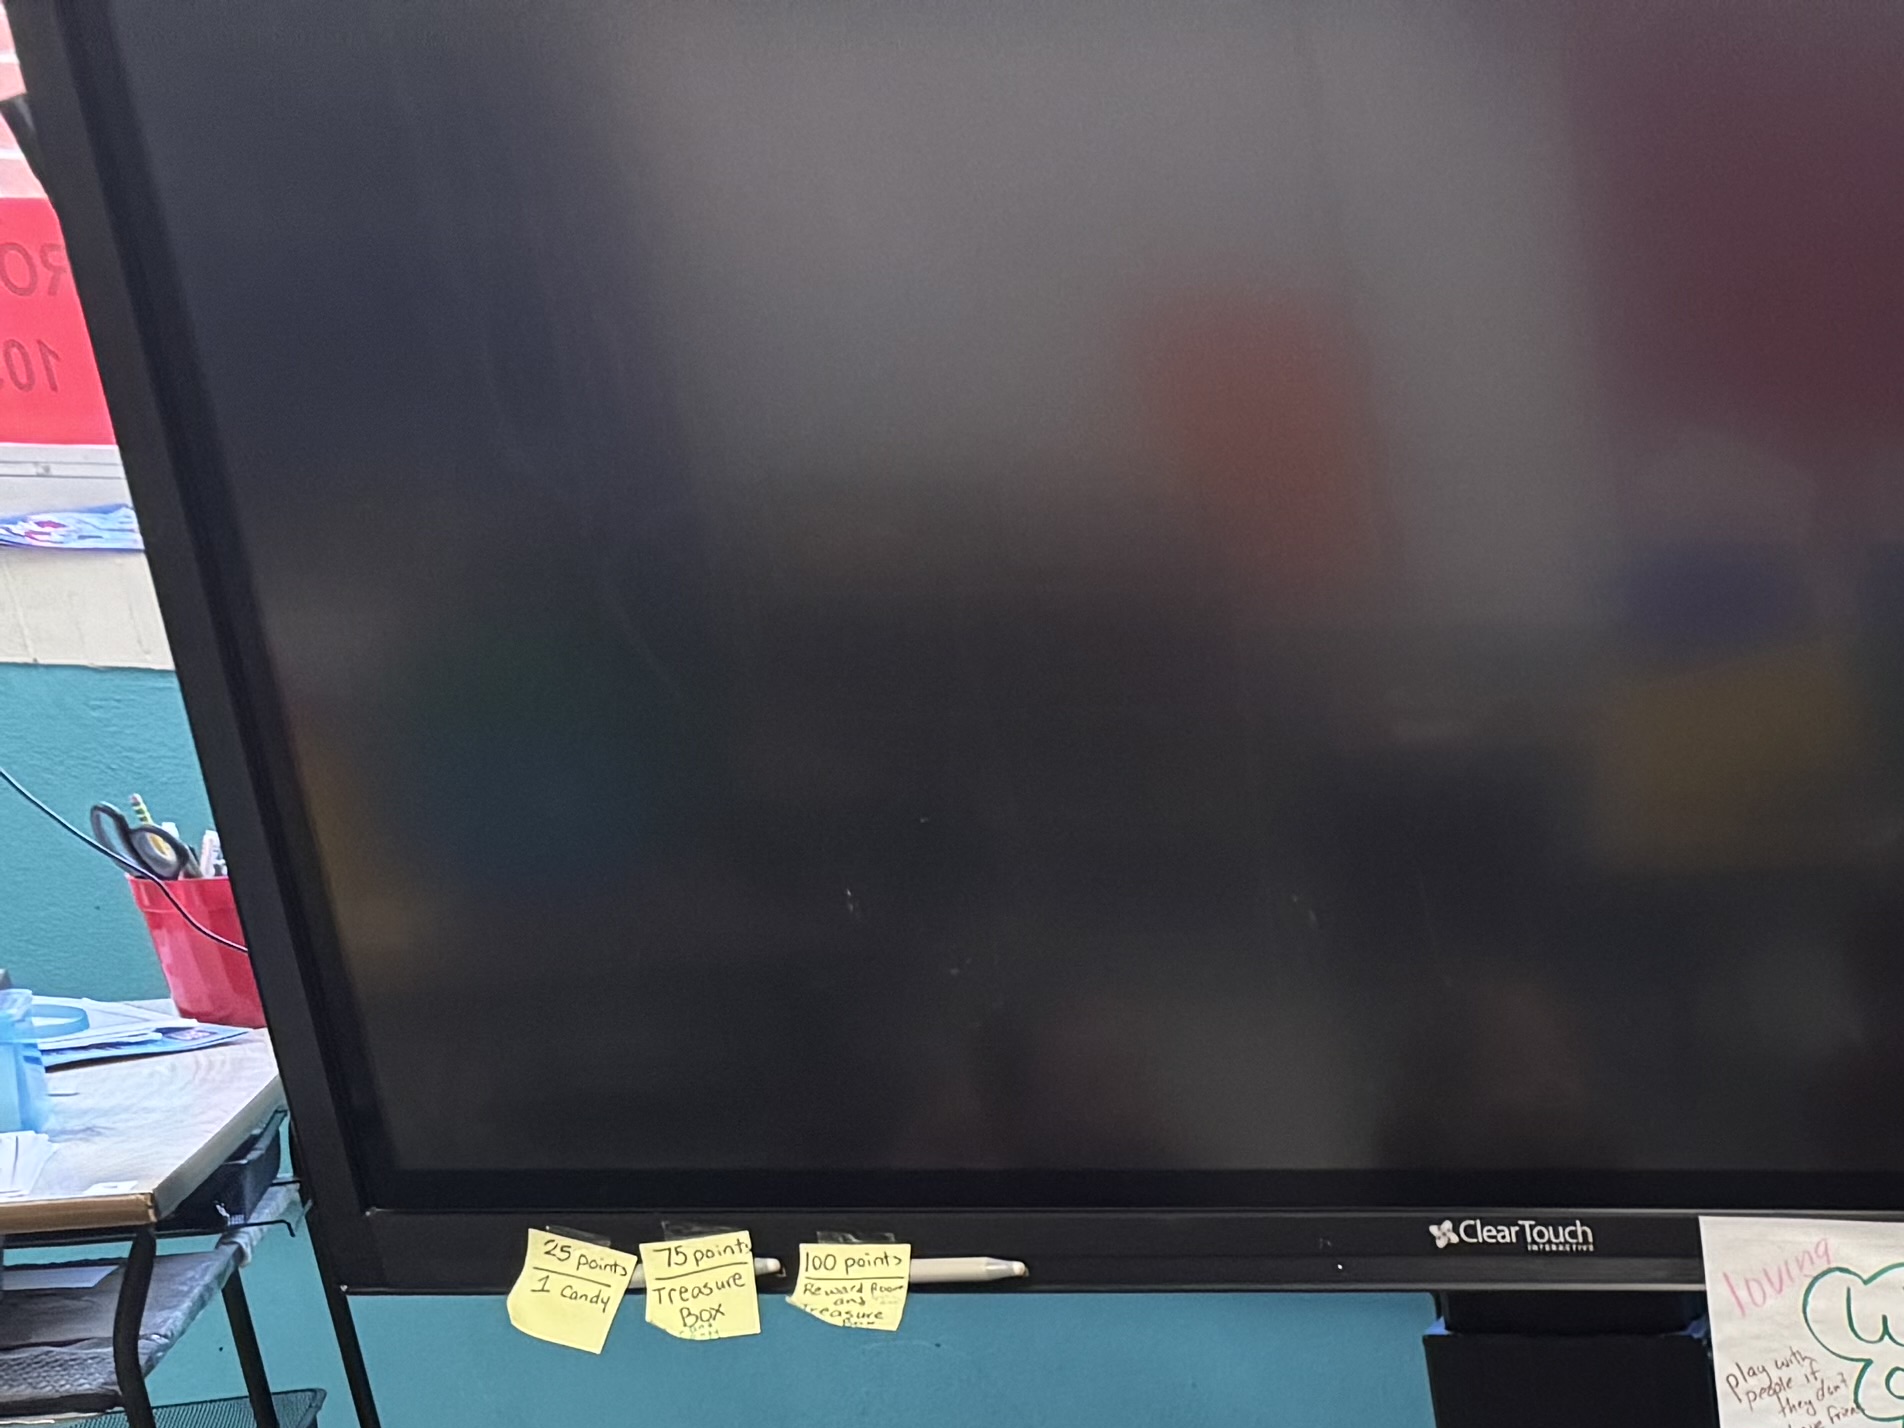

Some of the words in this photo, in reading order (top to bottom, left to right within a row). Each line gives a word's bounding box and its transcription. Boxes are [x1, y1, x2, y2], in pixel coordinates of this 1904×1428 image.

[1459, 1219, 1593, 1243] ClearTouch
[544, 1239, 571, 1262] 25
[577, 1253, 628, 1276] points
[653, 1246, 687, 1268] 75
[805, 1252, 836, 1272] 100
[845, 1251, 902, 1275] points
[531, 1275, 550, 1293] 1
[652, 1272, 746, 1305] Treasure
[1723, 1238, 1831, 1317] loving
[680, 1304, 725, 1327] Box
[1726, 1362, 1772, 1403] play
[1775, 1346, 1818, 1370] with
[1746, 1377, 1793, 1412] people
[1804, 1361, 1820, 1383] if
[1777, 1395, 1817, 1418] they
